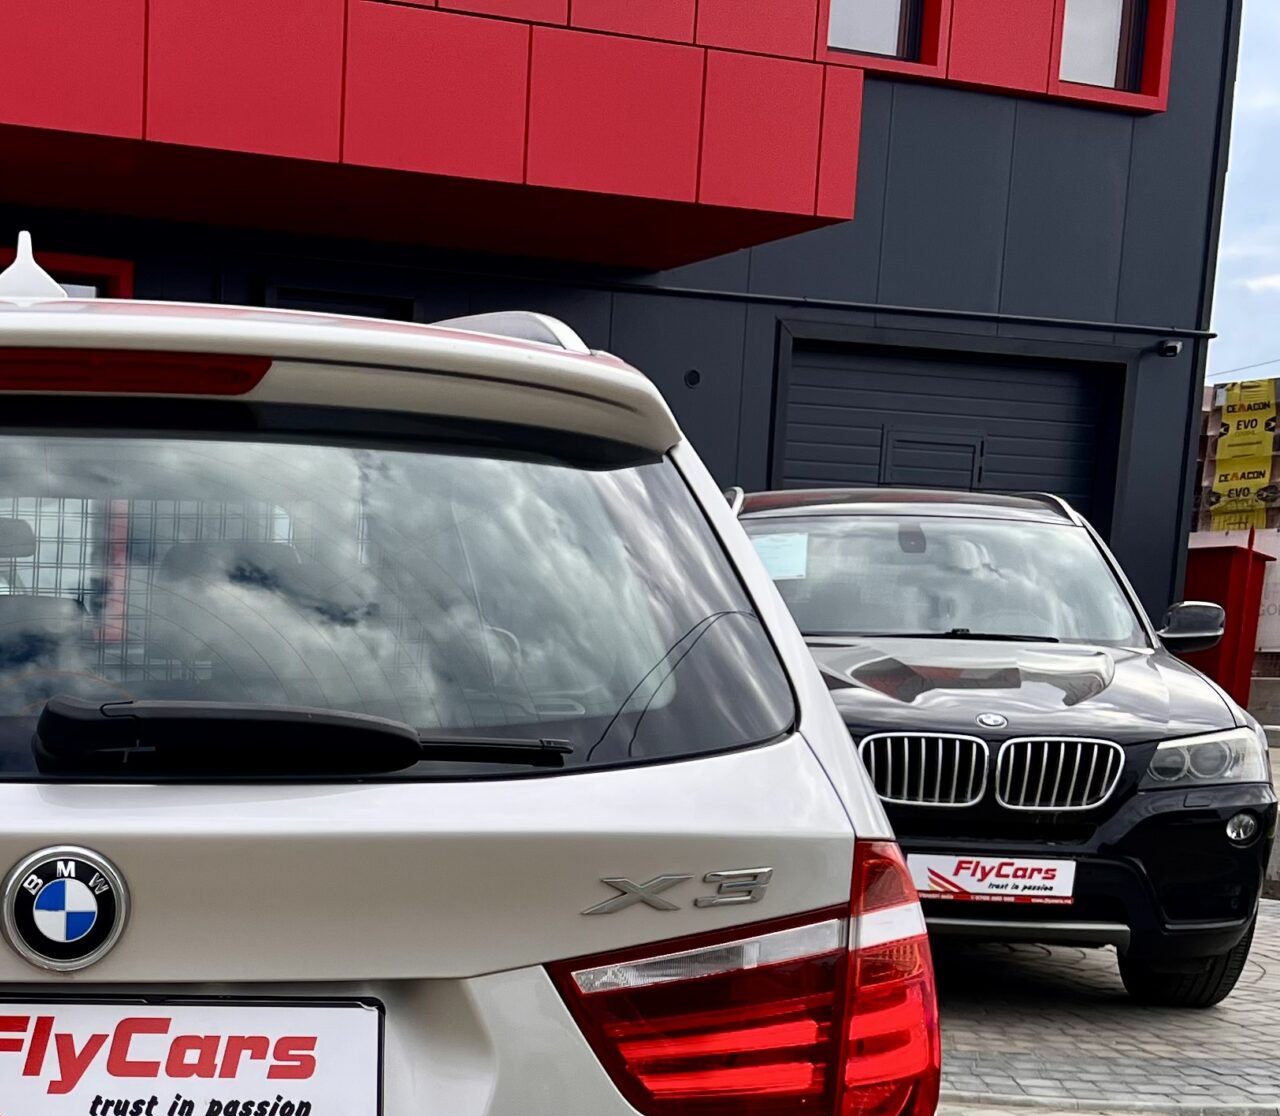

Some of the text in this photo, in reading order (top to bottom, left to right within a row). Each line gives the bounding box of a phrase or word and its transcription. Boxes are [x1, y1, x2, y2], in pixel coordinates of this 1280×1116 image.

[1236, 418, 1258, 430] EVO
[1227, 487, 1250, 498] EVO
[23, 860, 109, 896] BMW
[952, 860, 1057, 882] FlyCars
[580, 866, 774, 915] X3
